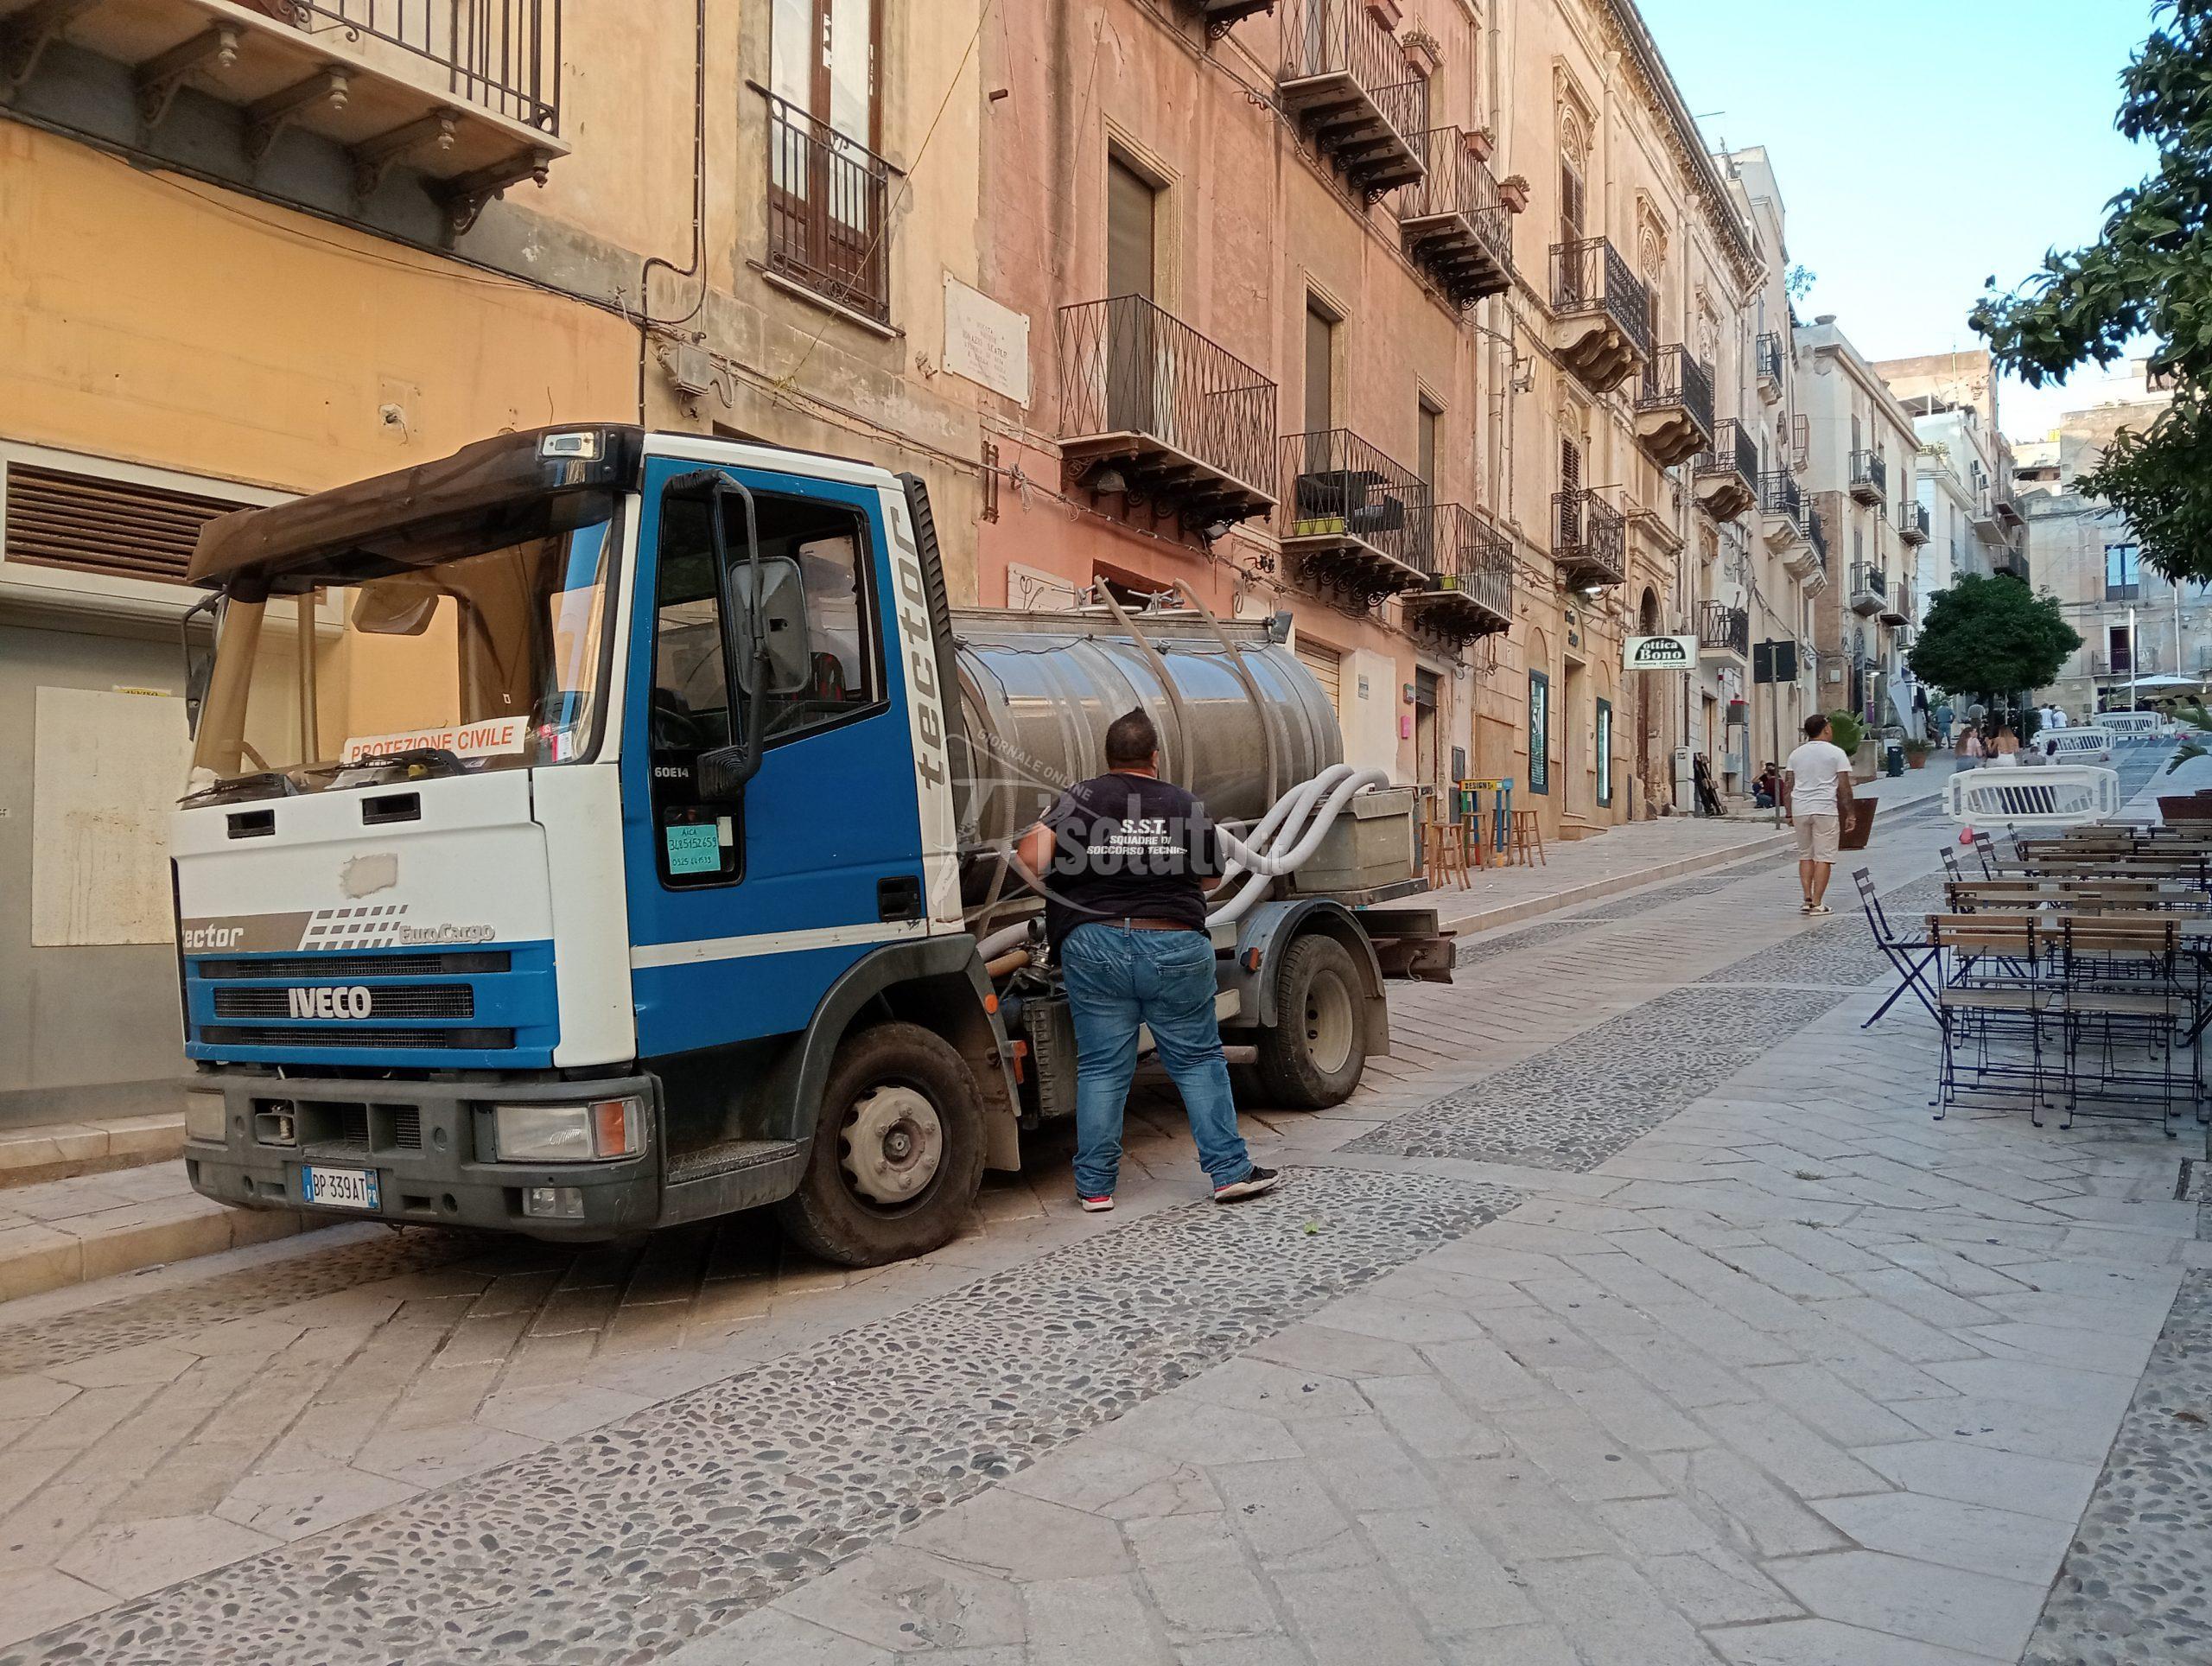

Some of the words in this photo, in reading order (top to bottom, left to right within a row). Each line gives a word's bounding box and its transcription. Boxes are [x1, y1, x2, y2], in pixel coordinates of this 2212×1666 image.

[890, 506, 944, 790] tector
[1643, 639, 1678, 650] ottica
[1640, 649, 1682, 659] Bono
[352, 733, 453, 762] PROTEZIONE
[458, 725, 514, 750] CIVILE
[654, 766, 690, 778] 60E14
[1120, 818, 1166, 835] S.S.T.
[1109, 835, 1159, 846] SQUADRE
[1086, 845, 1145, 855] SOCCORSO
[182, 923, 245, 949] ector
[288, 986, 372, 1019] IVECO
